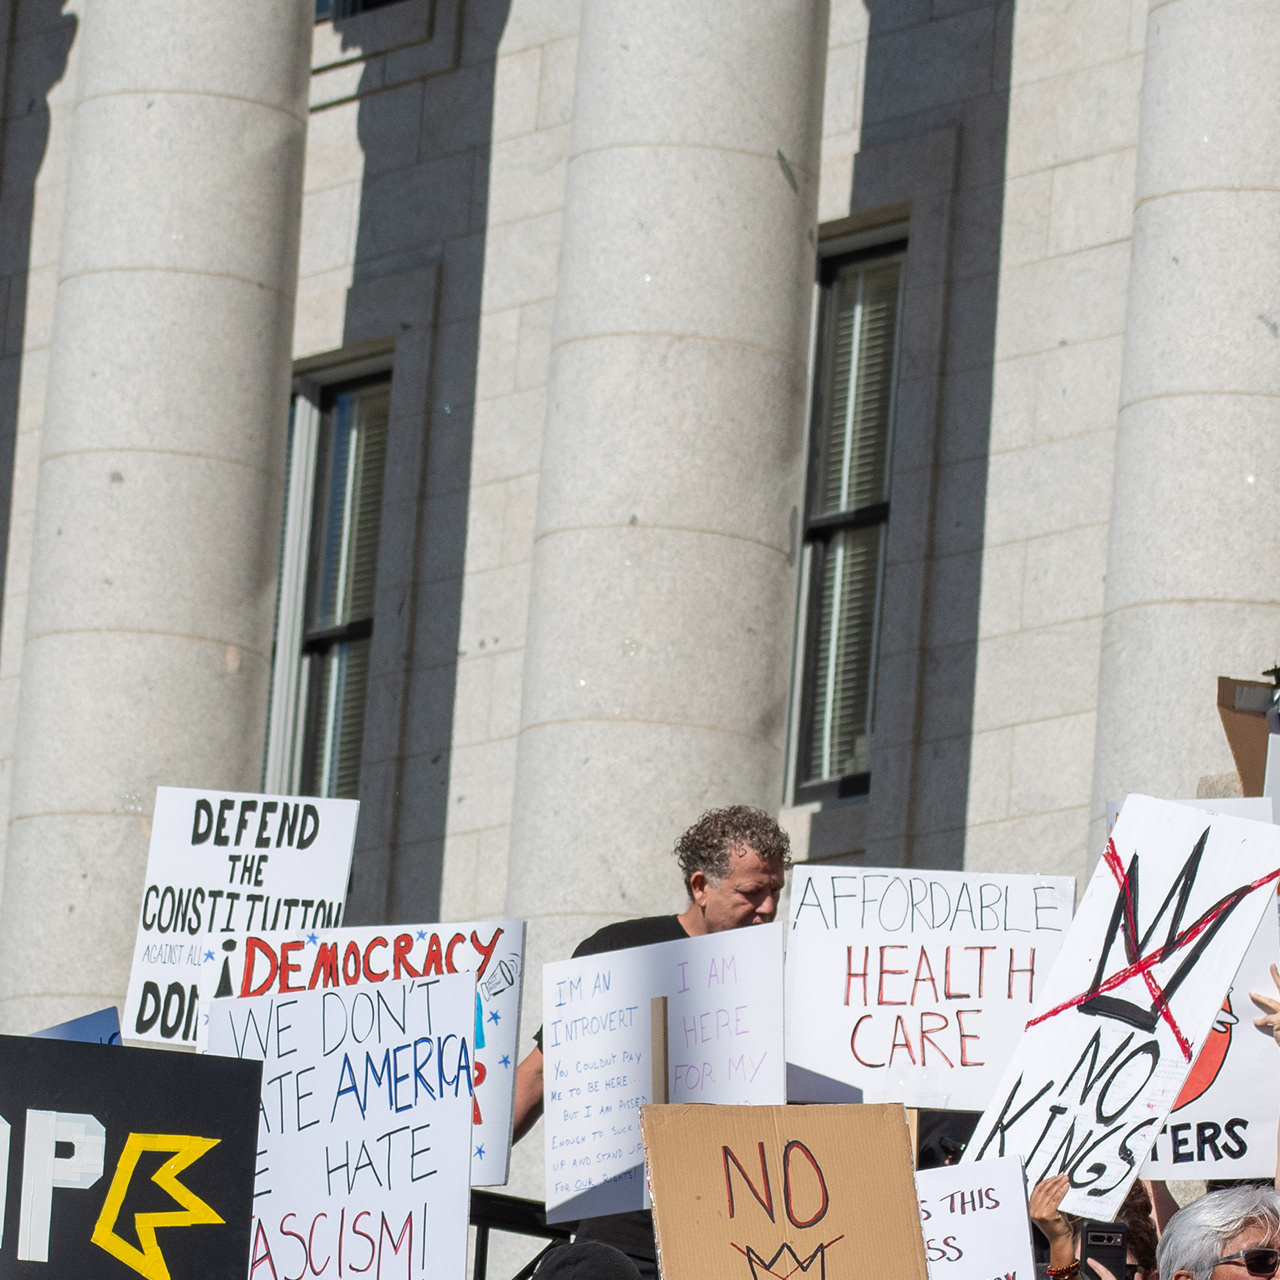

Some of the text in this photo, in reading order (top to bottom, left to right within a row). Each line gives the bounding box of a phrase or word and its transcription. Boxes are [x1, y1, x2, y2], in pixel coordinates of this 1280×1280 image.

[192, 798, 320, 850] DEFEND
[228, 854, 269, 887] THE
[792, 875, 1063, 933] AFFORDABLE
[142, 943, 184, 965] AGAINST
[556, 971, 611, 1007] I'M AN
[678, 956, 737, 994] I AM
[845, 945, 1035, 1006] HEALTH
[229, 980, 441, 1059] WE DON'T
[551, 1006, 638, 1047] INTROVERT
[683, 1005, 749, 1048] HERE
[851, 1010, 986, 1069] CARE
[330, 1033, 474, 1124] AMERICA
[551, 1081, 599, 1102] ME TO BE
[674, 1052, 767, 1093] FOR MY
[1060, 1026, 1160, 1125] NO
[564, 1096, 647, 1121] BUT I AM PISSED
[552, 1135, 586, 1150] ENOUGH
[592, 1131, 604, 1142] TO
[974, 1070, 1156, 1197] KINGS
[325, 1124, 438, 1196] HATE
[553, 1150, 623, 1171] UP AND STAND
[555, 1183, 571, 1193] FOR
[574, 1177, 594, 1191] OUR
[722, 1139, 830, 1229] NO
[940, 1187, 1000, 1215] THIS
